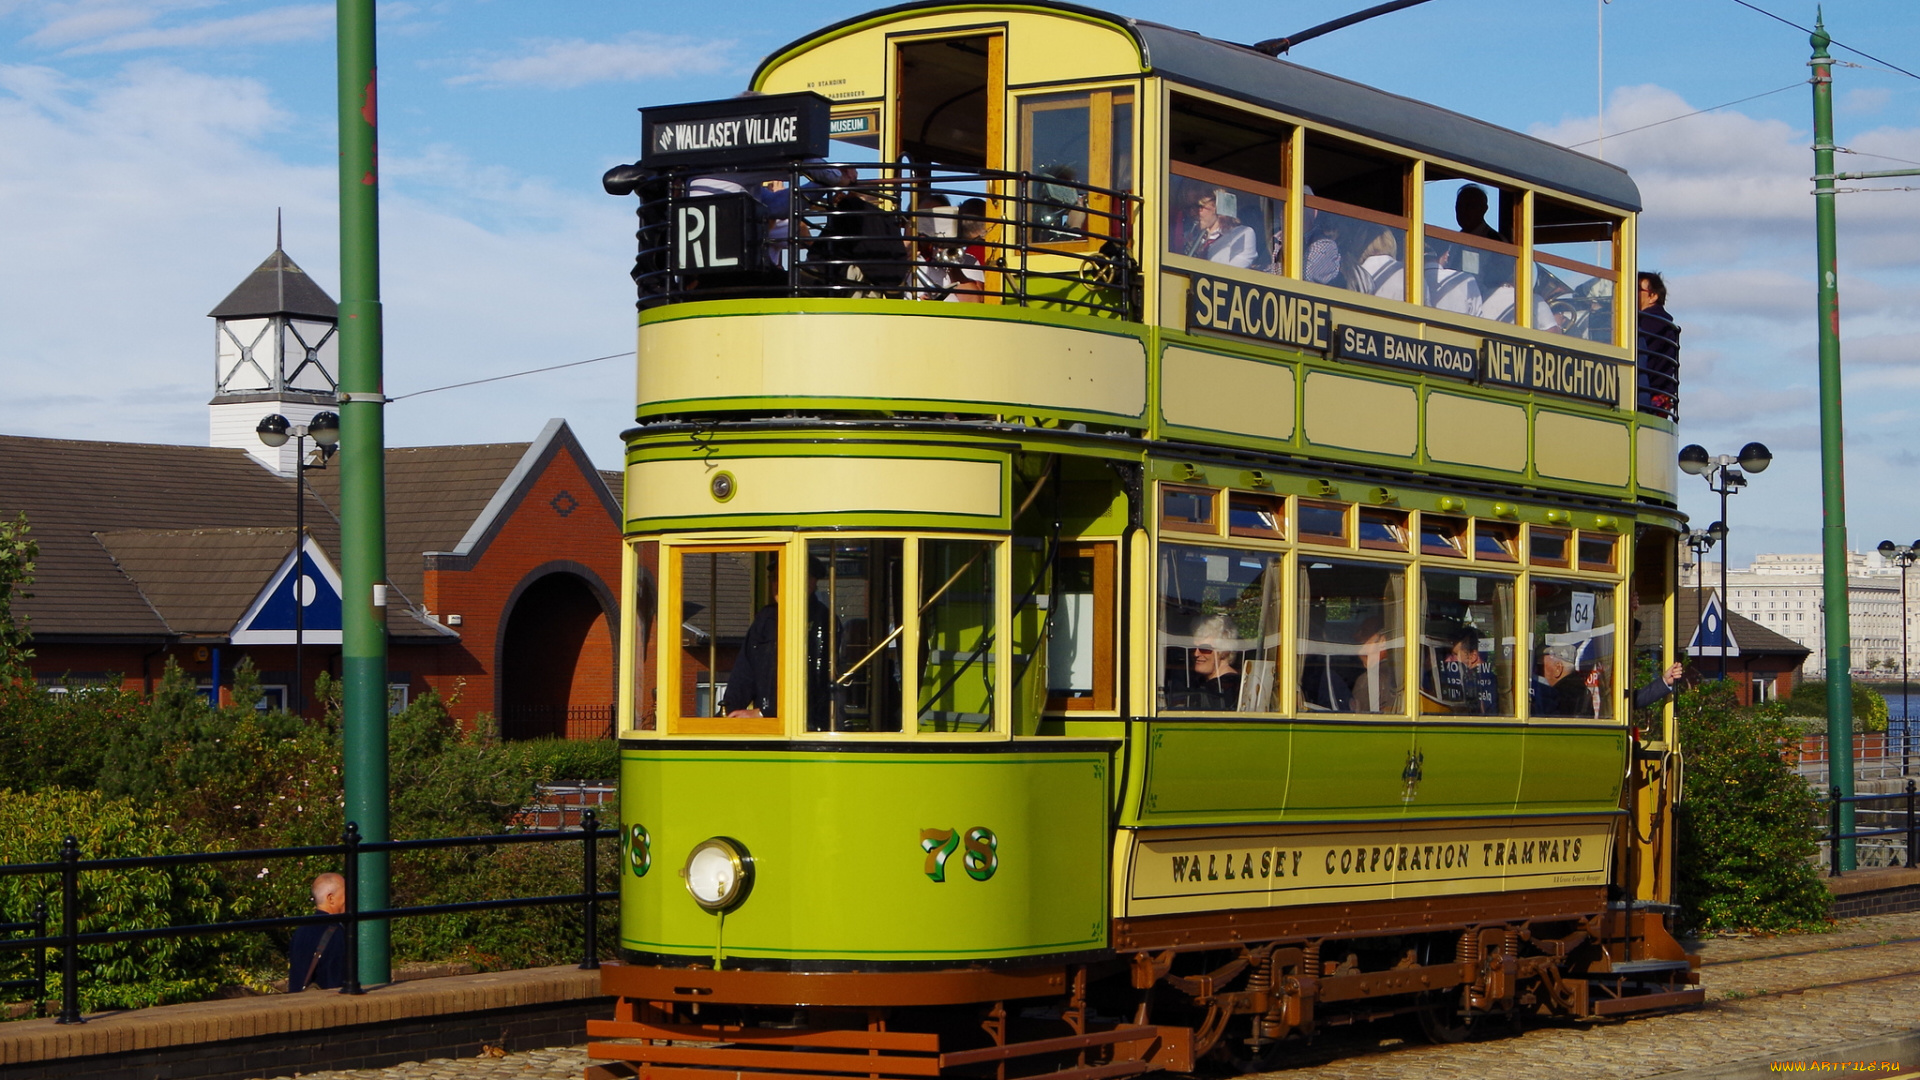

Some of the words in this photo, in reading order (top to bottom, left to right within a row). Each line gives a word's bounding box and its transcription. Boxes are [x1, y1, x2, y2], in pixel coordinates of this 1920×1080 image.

[818, 79, 847, 87] STANDING
[659, 126, 675, 150] VIA
[675, 122, 741, 150] WALLASEY
[746, 116, 798, 144] VILLAGE
[830, 118, 864, 132] MUSEUM
[678, 205, 738, 269] RL
[1195, 278, 1328, 348] SEACOMBE
[1344, 327, 1376, 356] SEA
[1384, 338, 1429, 365] BANK
[1434, 346, 1473, 373] ROAD
[1487, 341, 1527, 382] NEW
[1533, 351, 1617, 401] BRIGHTON
[1575, 603, 1588, 624] 64
[919, 826, 998, 882] 78
[1172, 852, 1302, 883] WALLASEY
[1325, 844, 1470, 874] CORPORATION
[1483, 838, 1582, 866] TRAMWAYS
